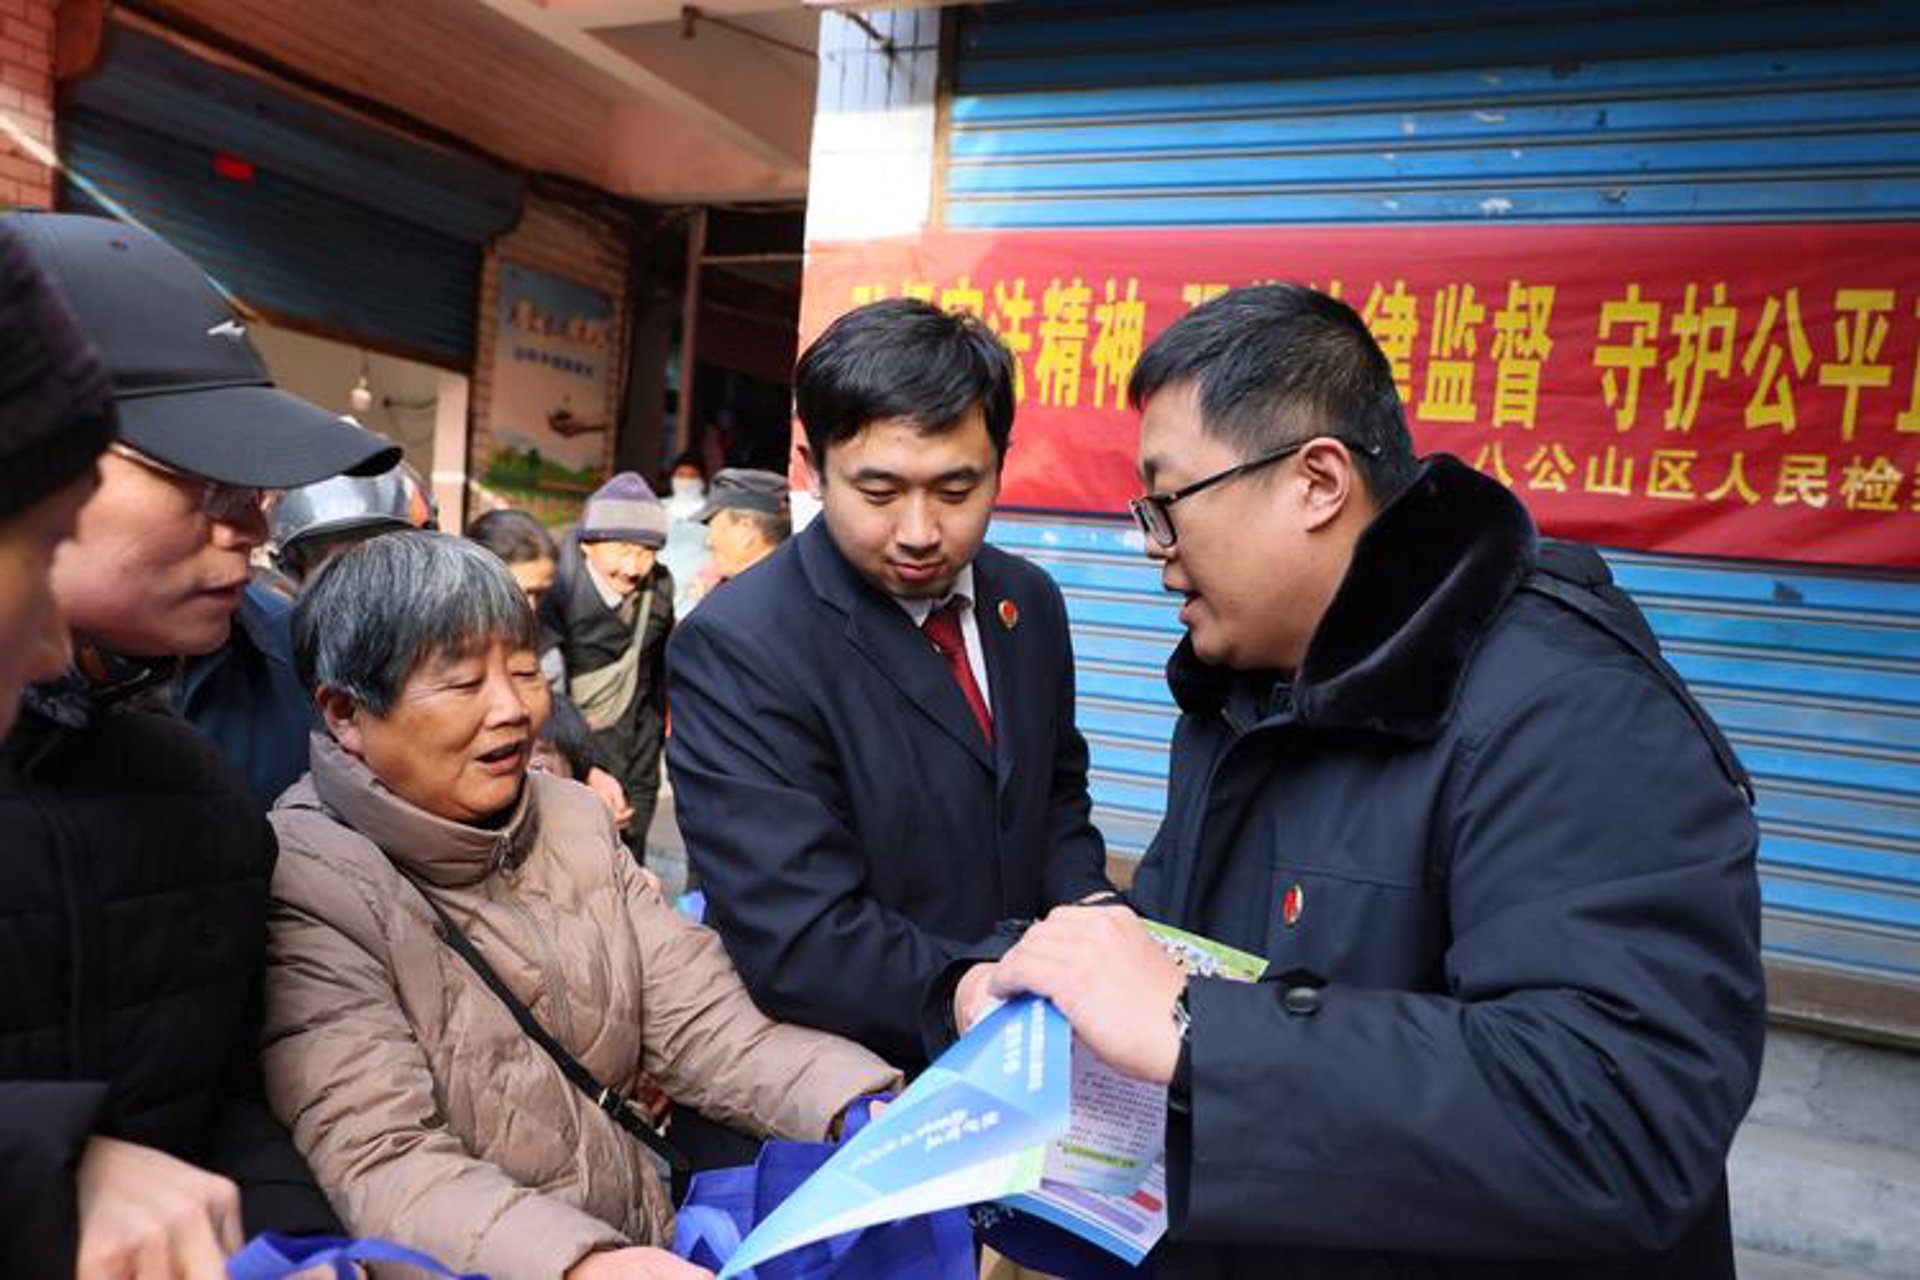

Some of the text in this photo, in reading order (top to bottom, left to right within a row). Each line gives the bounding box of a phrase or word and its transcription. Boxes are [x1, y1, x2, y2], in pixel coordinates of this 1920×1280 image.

[850, 277, 1147, 411] 法精神
[1183, 278, 1556, 429] 律监督
[1474, 443, 1920, 513] 八公山区人民检
